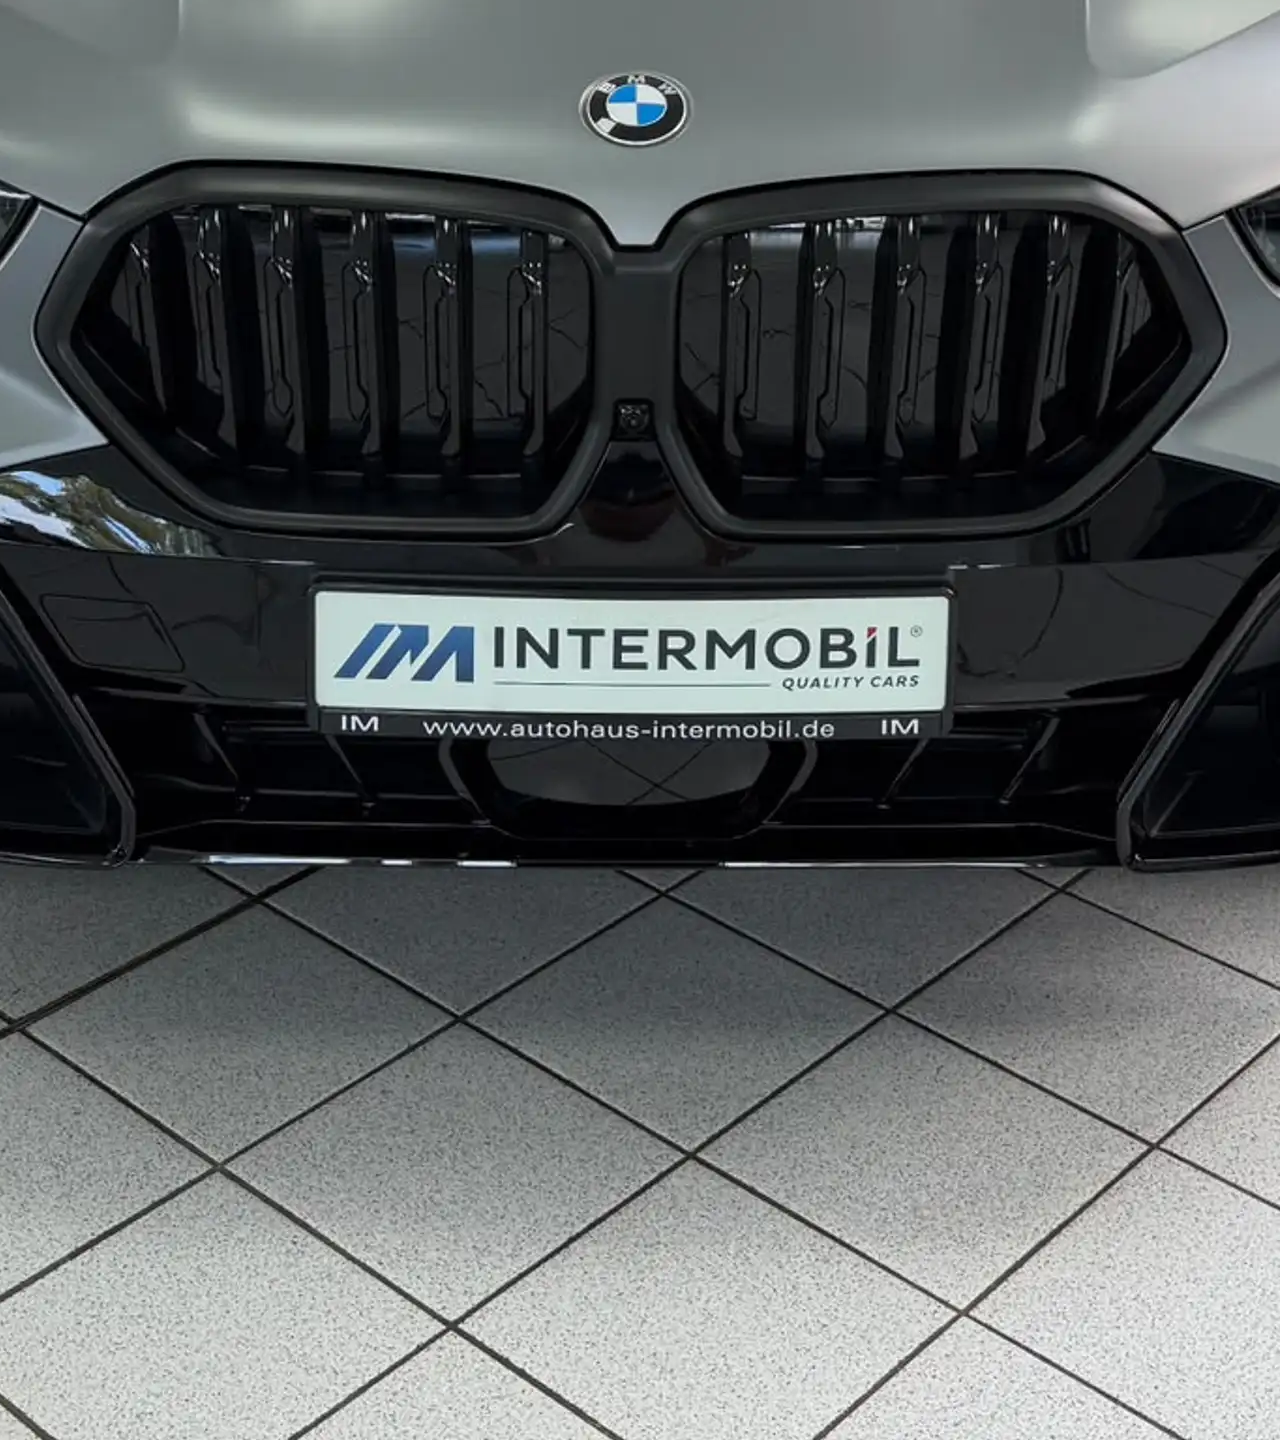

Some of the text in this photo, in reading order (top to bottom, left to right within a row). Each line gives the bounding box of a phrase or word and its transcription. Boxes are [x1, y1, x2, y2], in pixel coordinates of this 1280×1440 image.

[781, 674, 920, 692] QUALITY CARS
[340, 714, 920, 739] IM www.autohaus-intermobil.de IM
